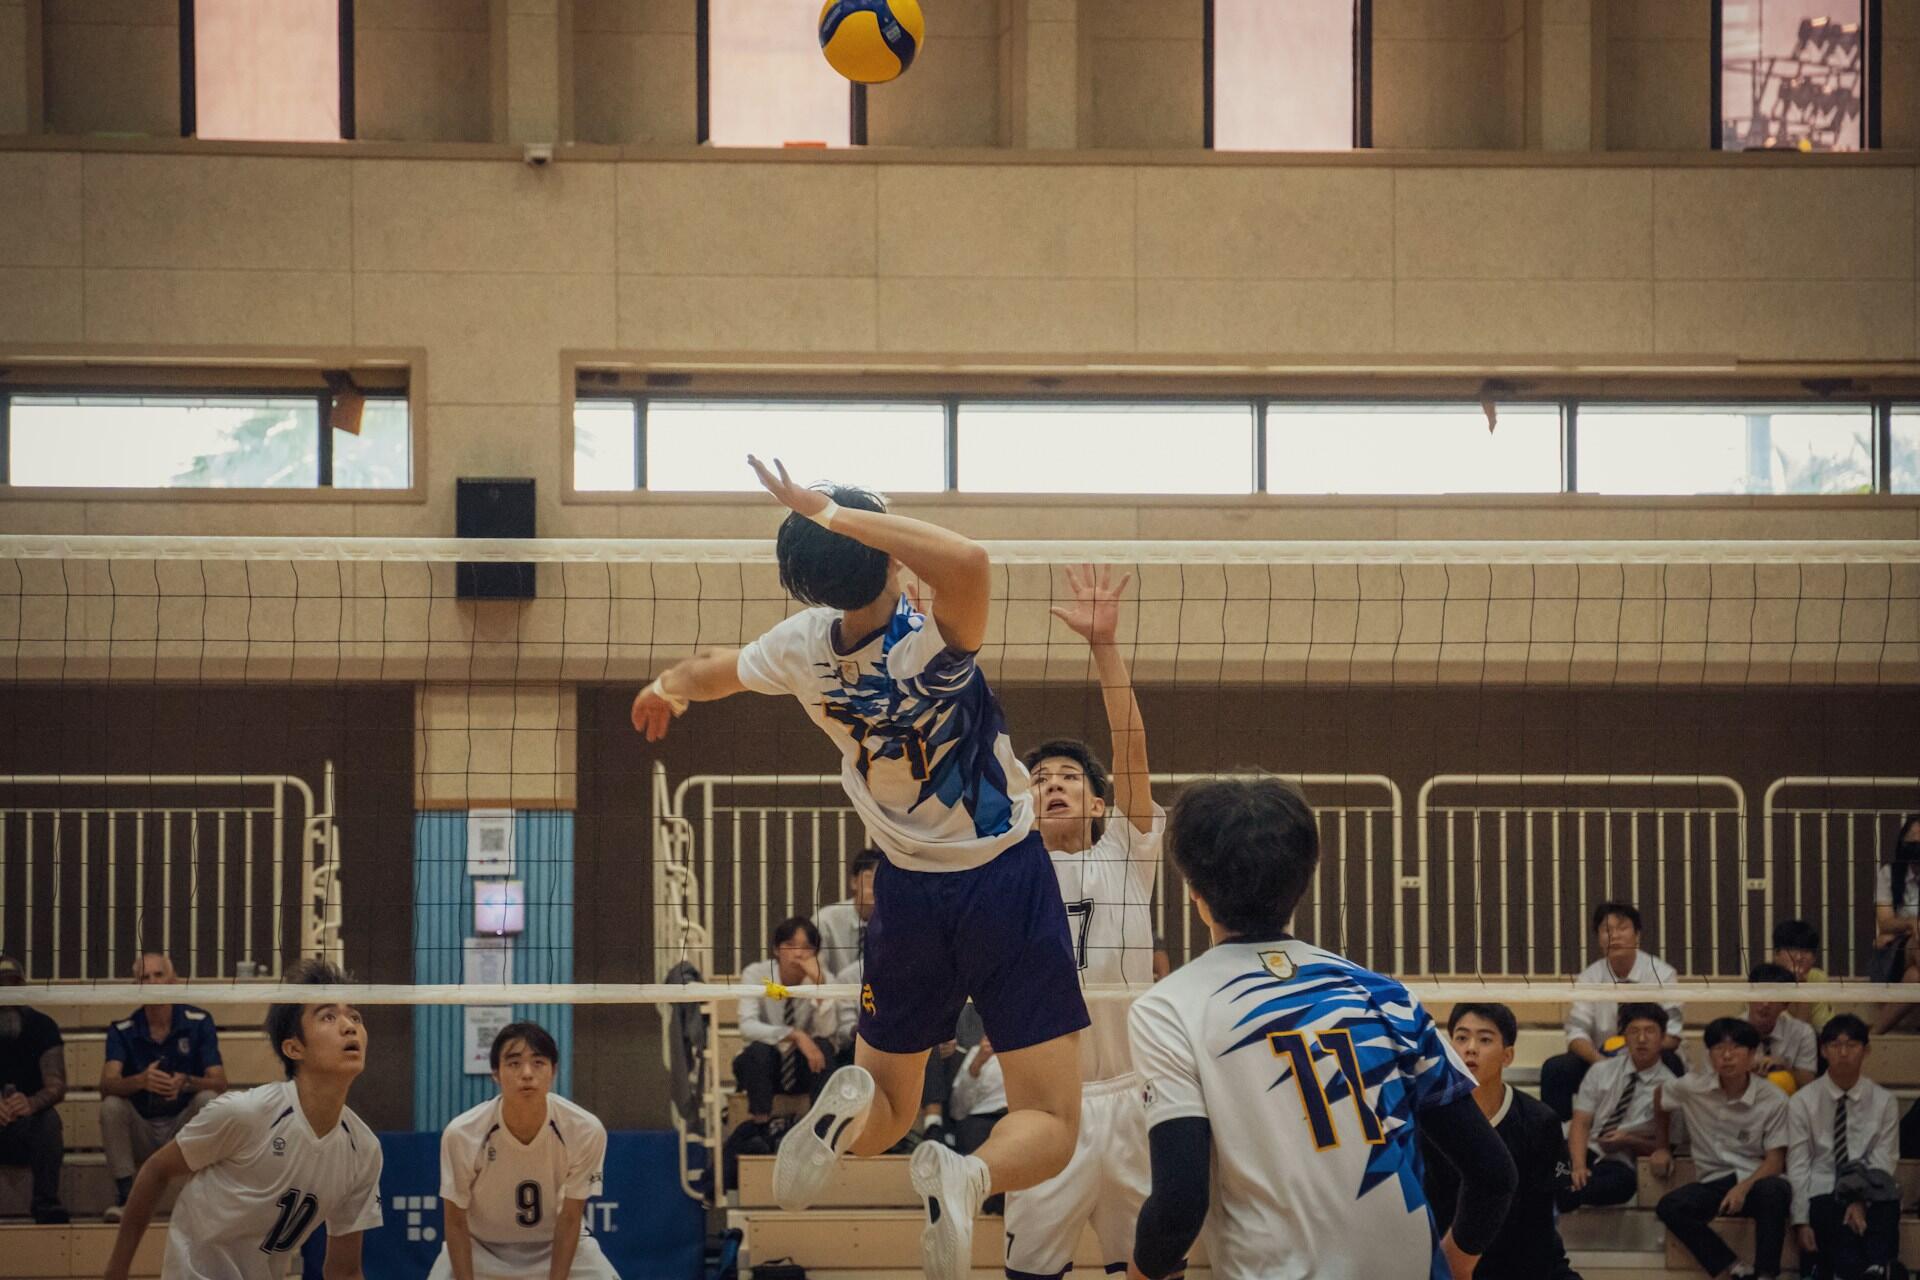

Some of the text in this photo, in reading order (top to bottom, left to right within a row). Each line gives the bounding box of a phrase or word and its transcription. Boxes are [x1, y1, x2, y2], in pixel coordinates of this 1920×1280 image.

[1064, 898, 1095, 971] 7
[1266, 1028, 1386, 1152] 11
[259, 1188, 318, 1255] 10
[515, 1179, 543, 1228] 9
[1006, 1231, 1015, 1260] 7
